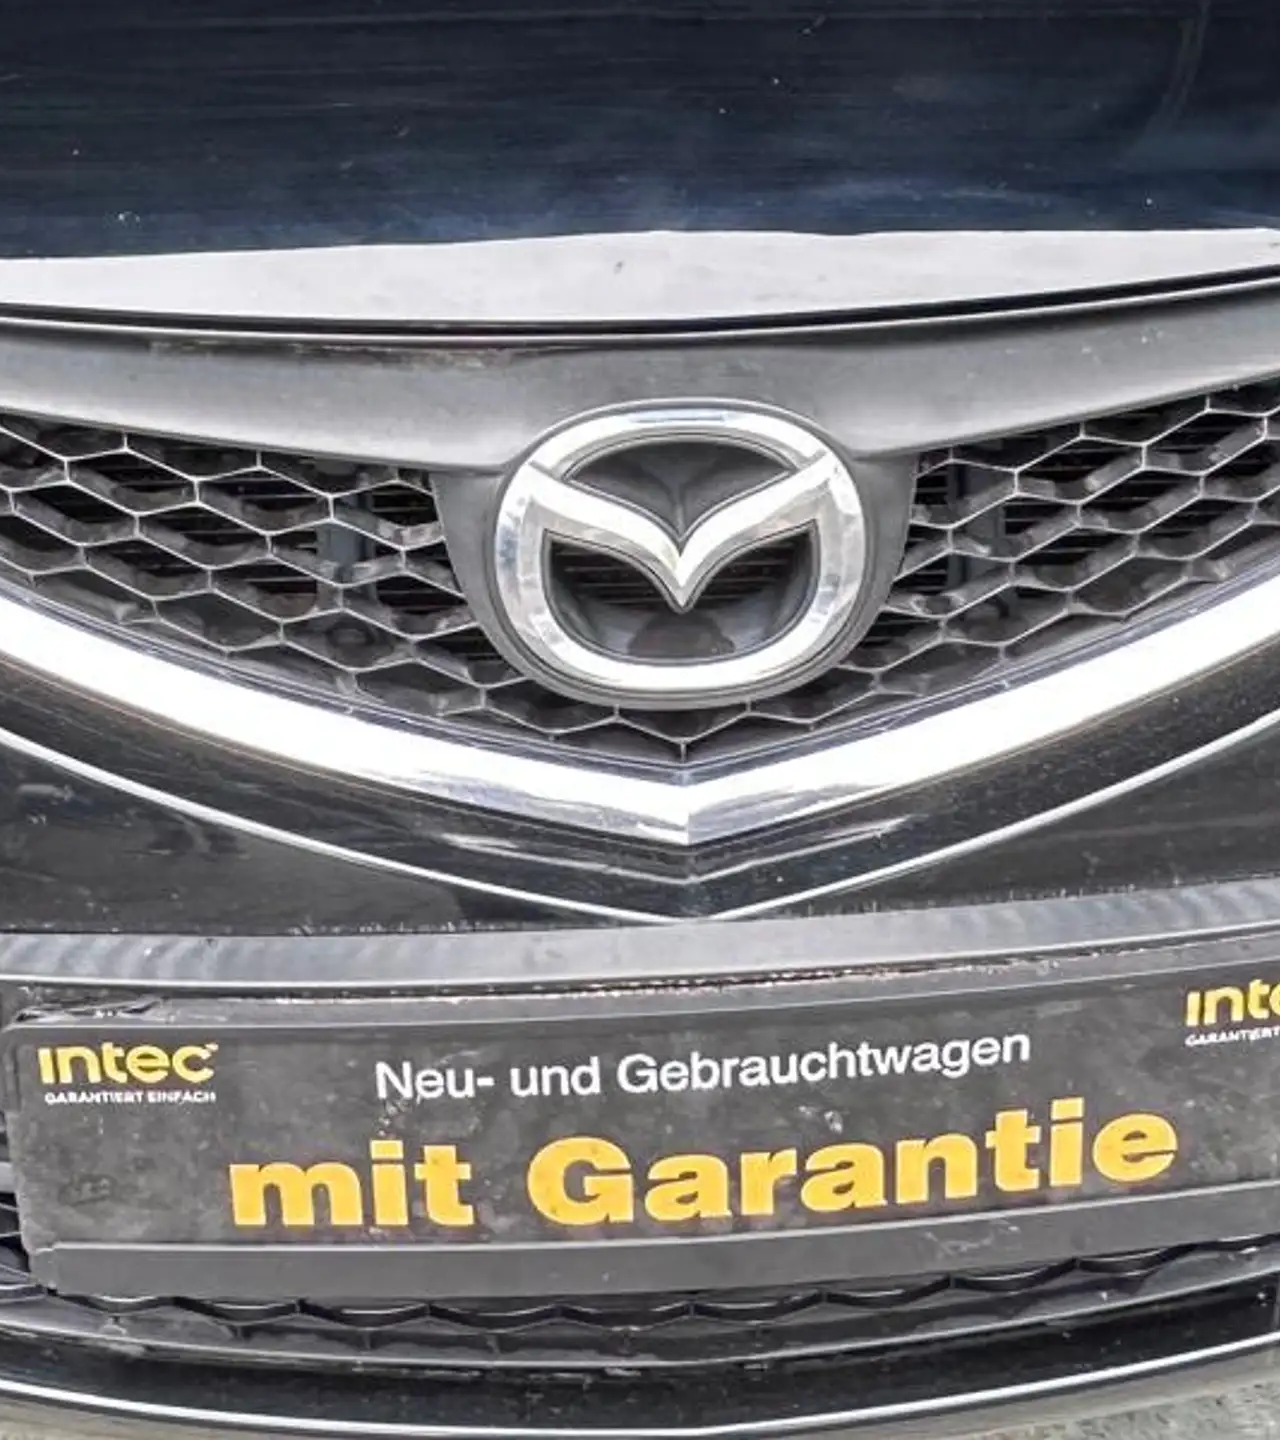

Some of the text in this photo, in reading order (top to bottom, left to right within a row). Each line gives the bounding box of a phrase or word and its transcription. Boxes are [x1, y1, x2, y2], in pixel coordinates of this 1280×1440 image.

[1185, 1025, 1280, 1047] GARANTIERT
[375, 1033, 1032, 1101] Neu- und Gebrauchtwagen
[44, 1090, 216, 1105] GARANTIERT EINFACH
[229, 1097, 1178, 1228] mit Garantie
